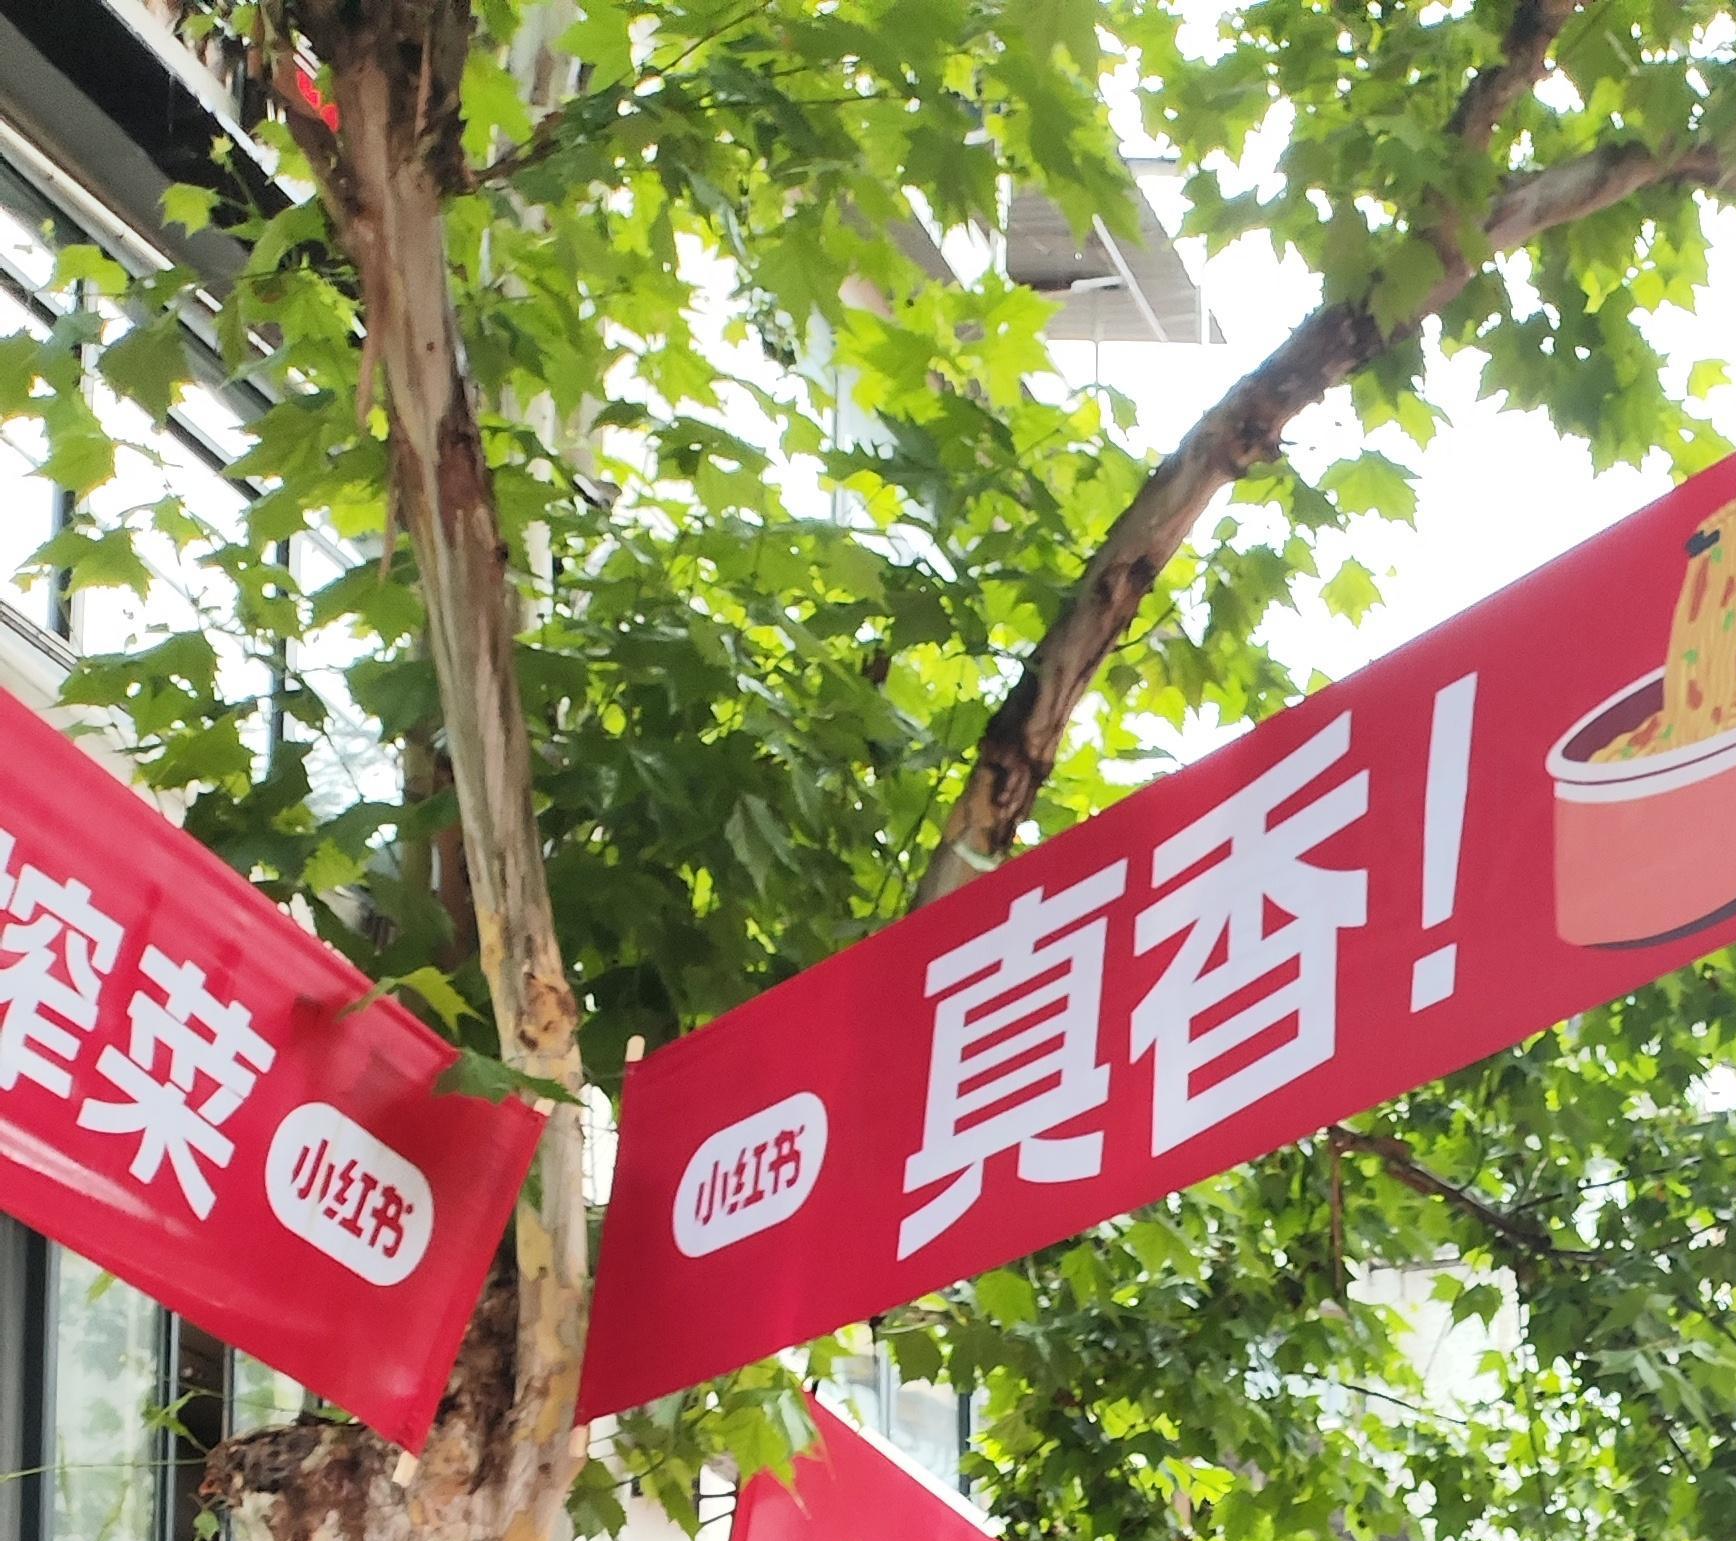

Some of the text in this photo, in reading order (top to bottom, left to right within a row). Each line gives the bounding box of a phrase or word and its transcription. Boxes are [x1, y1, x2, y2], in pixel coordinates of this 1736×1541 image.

[292, 1137, 413, 1261] 小红书
[696, 1124, 806, 1226] 小红书
